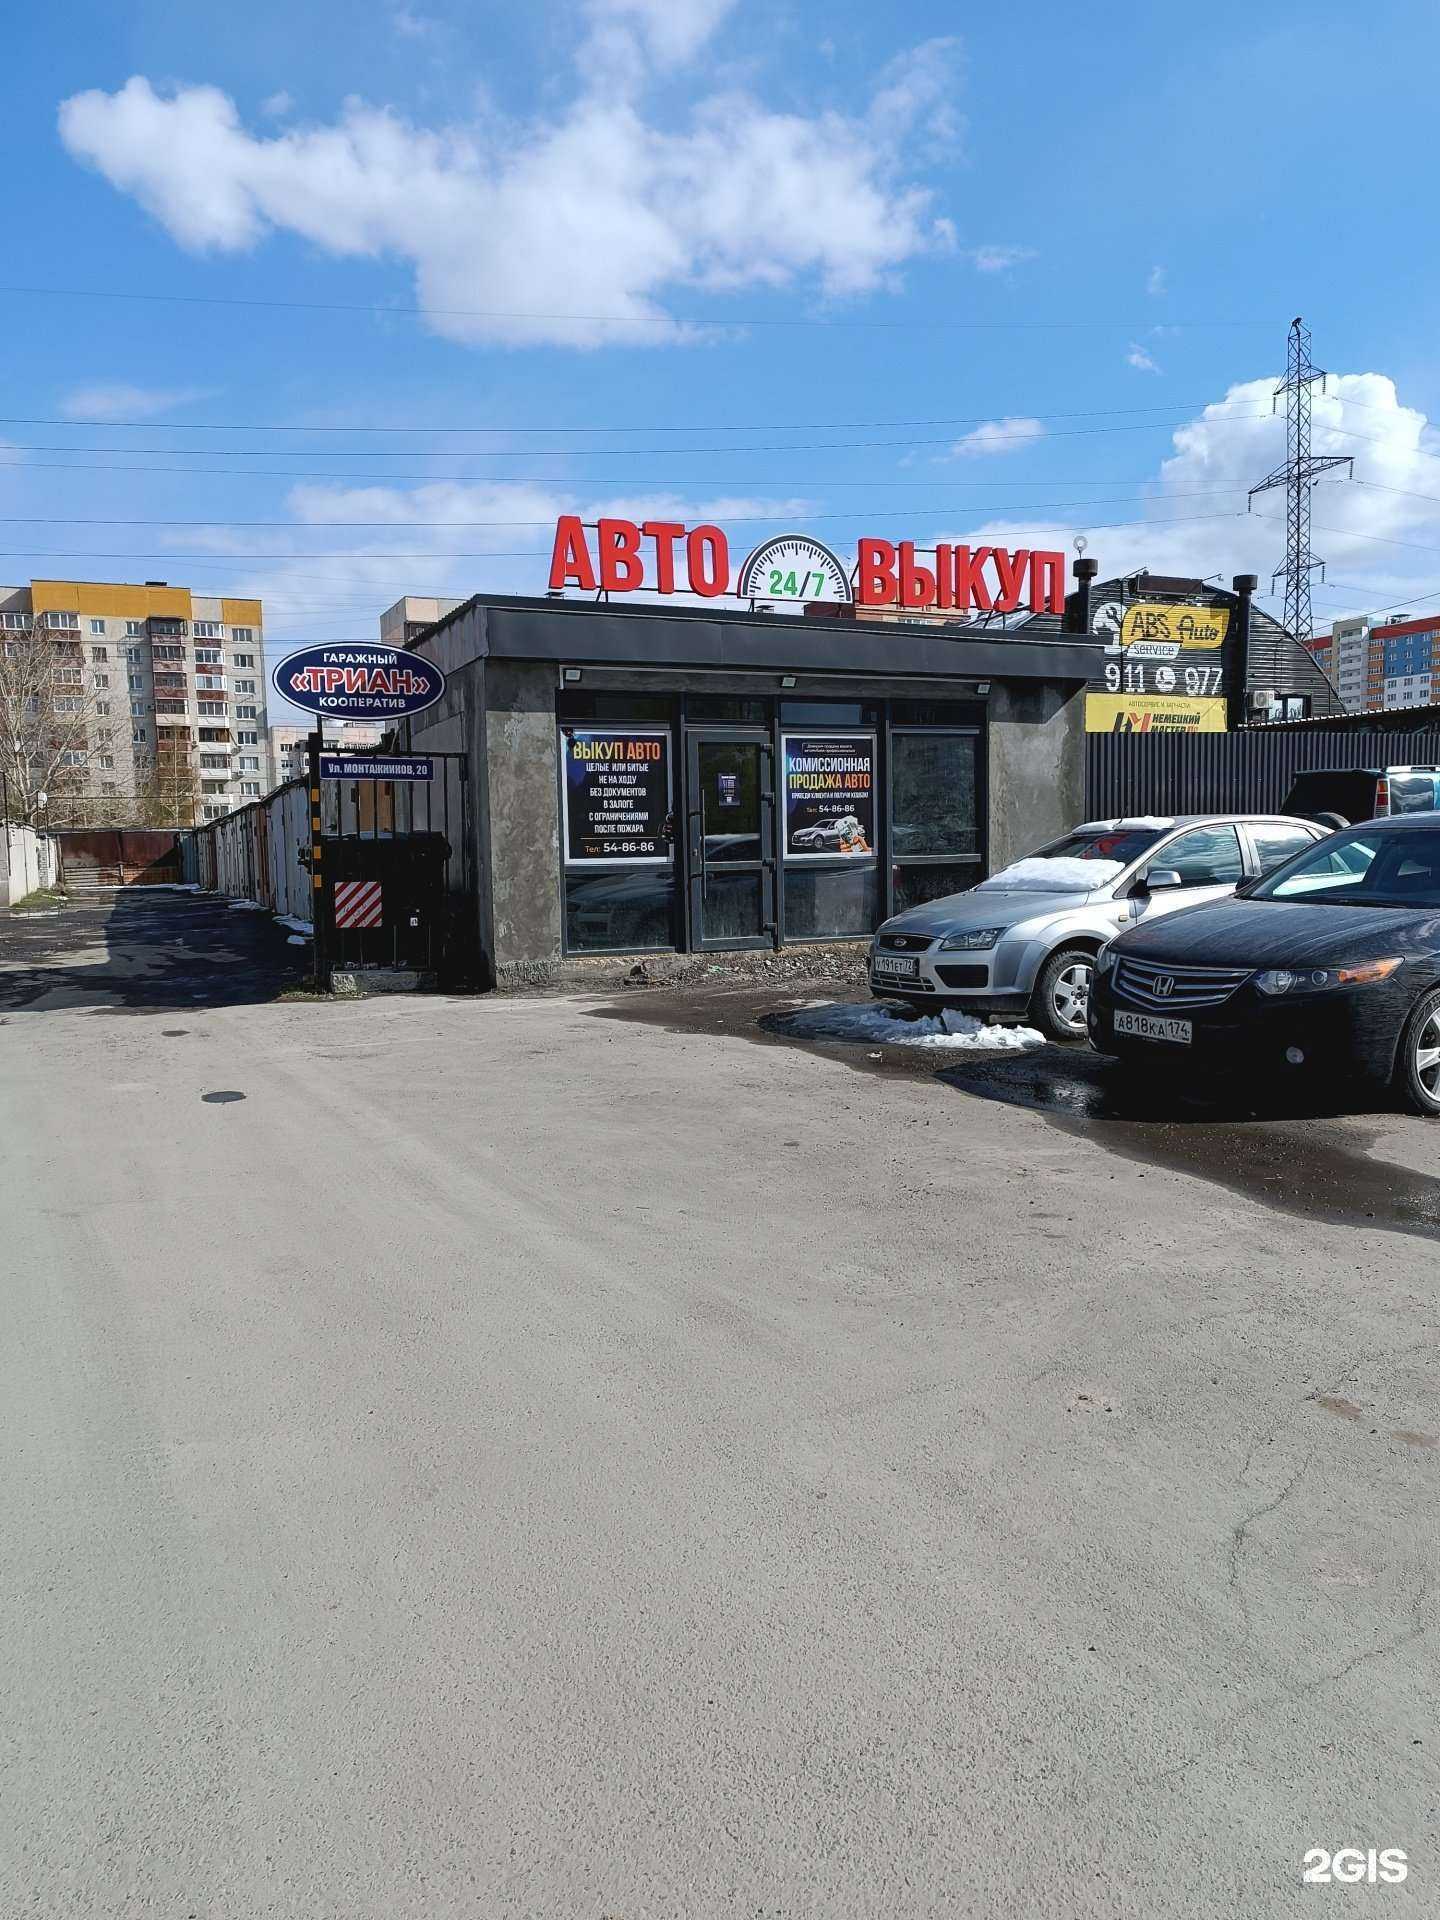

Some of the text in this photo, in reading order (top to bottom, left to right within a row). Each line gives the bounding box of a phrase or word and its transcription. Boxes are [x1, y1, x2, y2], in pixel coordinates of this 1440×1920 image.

[548, 516, 731, 598] АВТО
[858, 538, 1065, 614] ВЫКУП
[769, 570, 825, 598] 24/7
[1130, 611, 1220, 641] ABS Auto
[323, 652, 398, 665] ГАРАЖНЫЙ
[289, 666, 431, 695] «ТРИАН»
[1104, 663, 1223, 697] 911 977
[319, 697, 406, 708] КООПЕРАТИВ
[1152, 712, 1201, 725] НЕМЕЦКИЙ
[573, 741, 661, 760] ВЫКУП АВТО
[328, 763, 342, 773] Ул.
[416, 765, 427, 774] 20
[586, 763, 649, 772] ЦЕЛЫЕ ИЛИ БИТЫЕ
[789, 757, 870, 772] КОМИССИОННАЯ
[599, 776, 637, 785] НЕ НА ХОДУ
[789, 774, 870, 790] ПРОДАЖА АВТО
[589, 788, 647, 797] БЕЗ ДОКУМЕНТОВ
[603, 800, 634, 809] В ЗАЛОГЕ
[818, 804, 855, 813] 54-86-86
[589, 812, 649, 821] С ОГРАНИЧЕНИЯМИ
[594, 824, 644, 833] ПОСЛЕ ПОЖАРА
[603, 842, 655, 852] 54-86-86
[1168, 1022, 1187, 1037] 174
